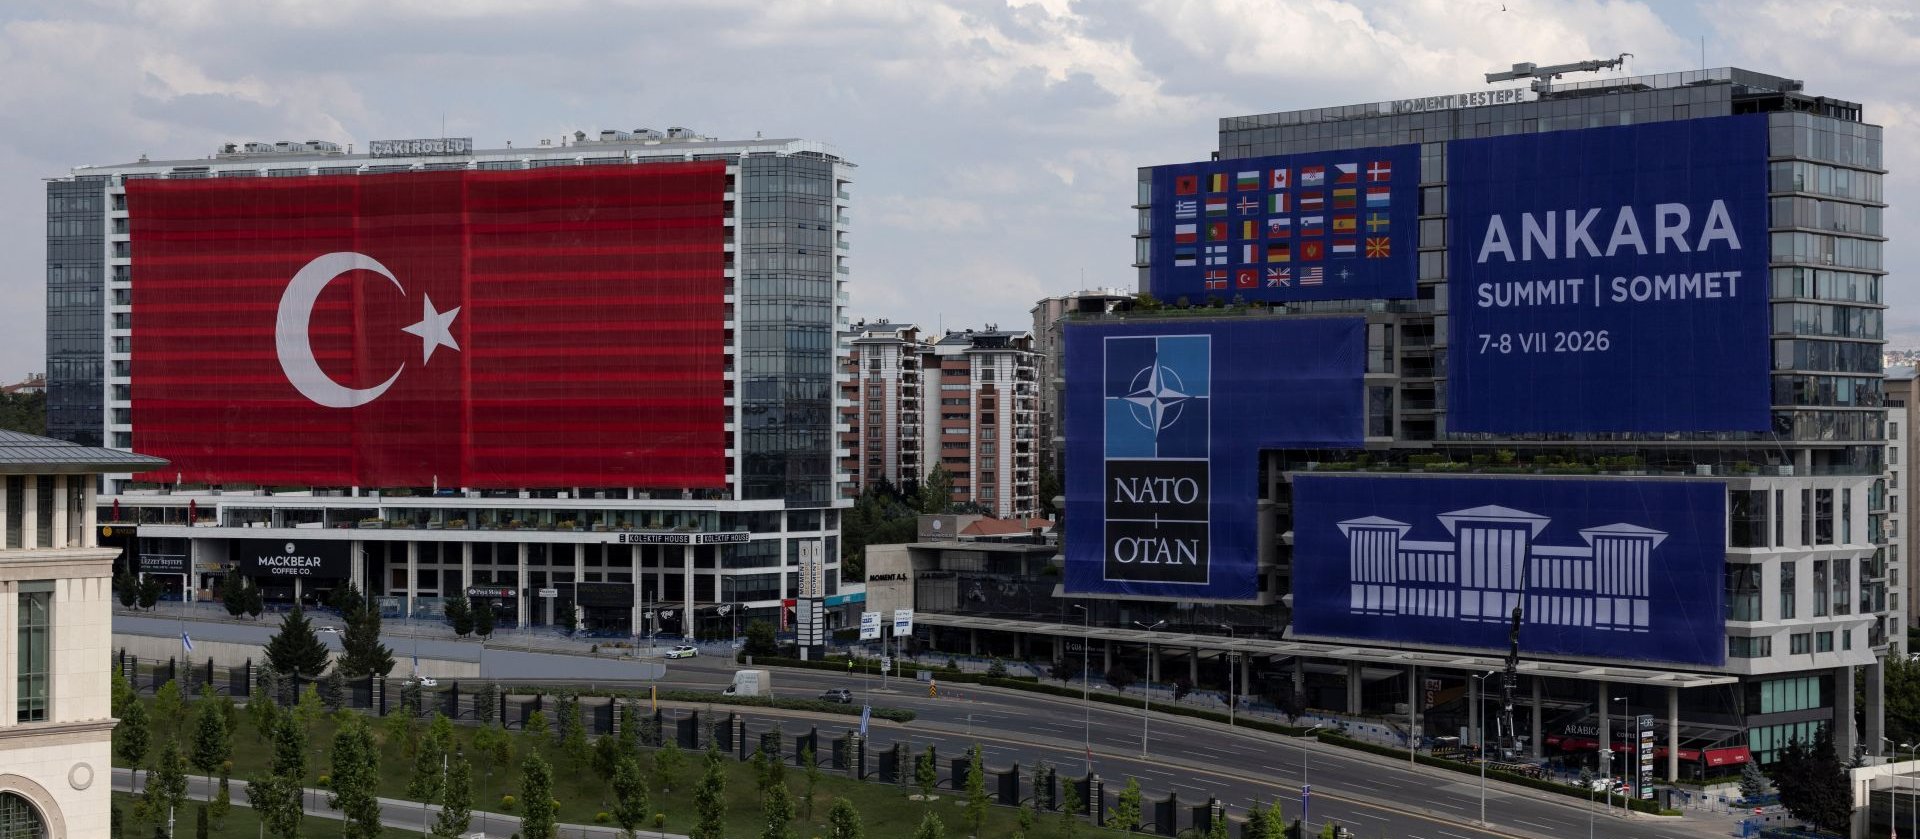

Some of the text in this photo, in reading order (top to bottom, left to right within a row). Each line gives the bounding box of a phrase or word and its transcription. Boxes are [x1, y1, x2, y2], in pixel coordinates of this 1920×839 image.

[1391, 95, 1454, 114] MOMENT
[1477, 199, 1742, 263] ANKARA
[1477, 278, 1584, 307] SUMMIT
[1611, 271, 1742, 302] SOMMET
[1478, 330, 1610, 354] 7-8 VII 2026
[1113, 476, 1199, 504] NATO
[664, 535, 688, 543] HOUSE
[730, 533, 749, 541] HOUSE
[1113, 536, 1199, 565] OTAN
[258, 556, 321, 567] MACKBEAR
[271, 567, 298, 575] COFFEE
[869, 573, 896, 582] MOMENT
[1564, 724, 1600, 736] ARABICA
